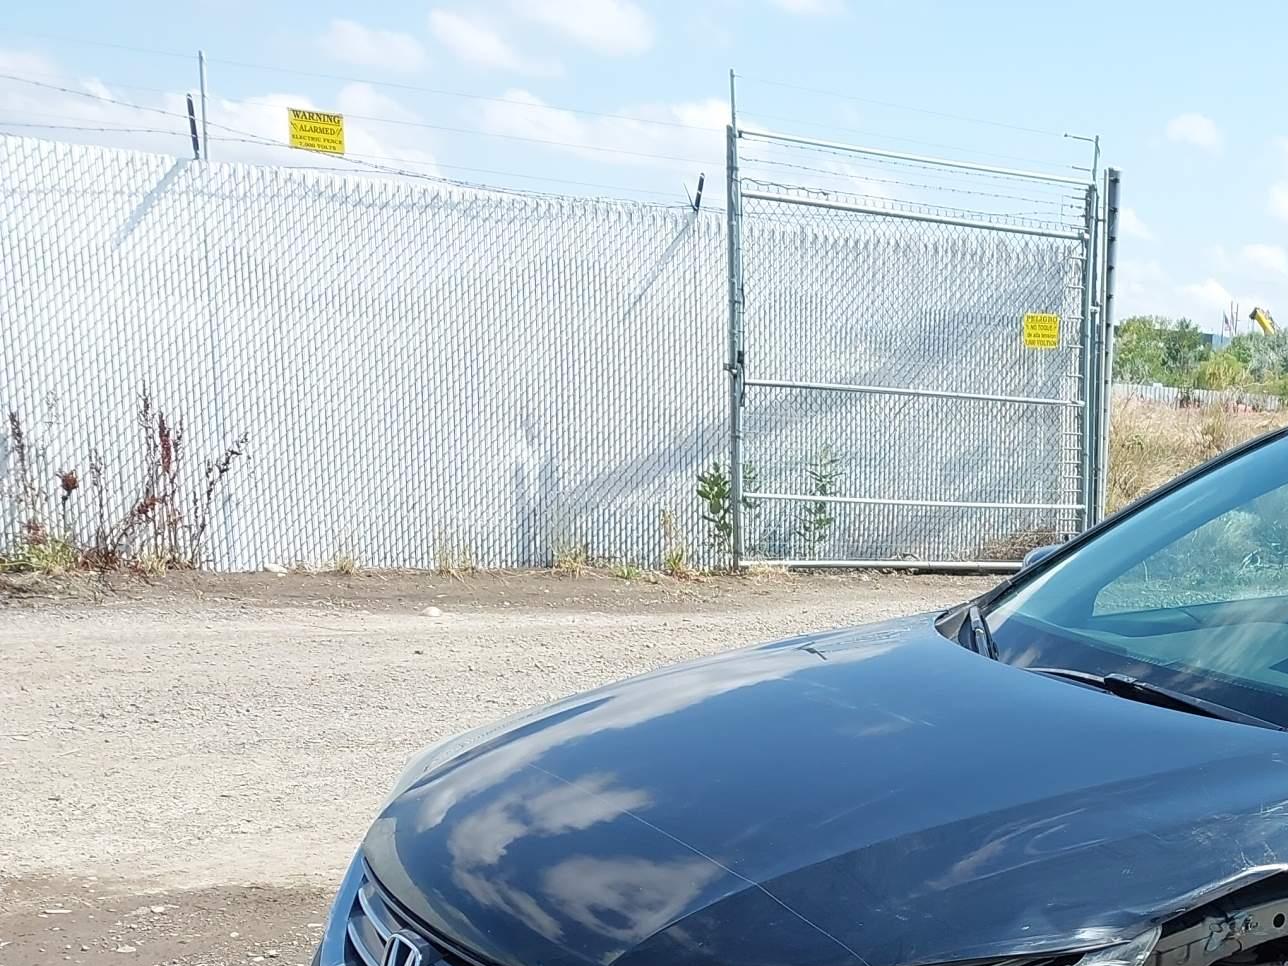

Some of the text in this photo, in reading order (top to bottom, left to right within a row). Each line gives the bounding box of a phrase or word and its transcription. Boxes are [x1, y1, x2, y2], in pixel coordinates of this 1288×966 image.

[292, 110, 340, 124] WARNING
[299, 124, 335, 135] ALARMED
[292, 134, 321, 142] ELECTRIC
